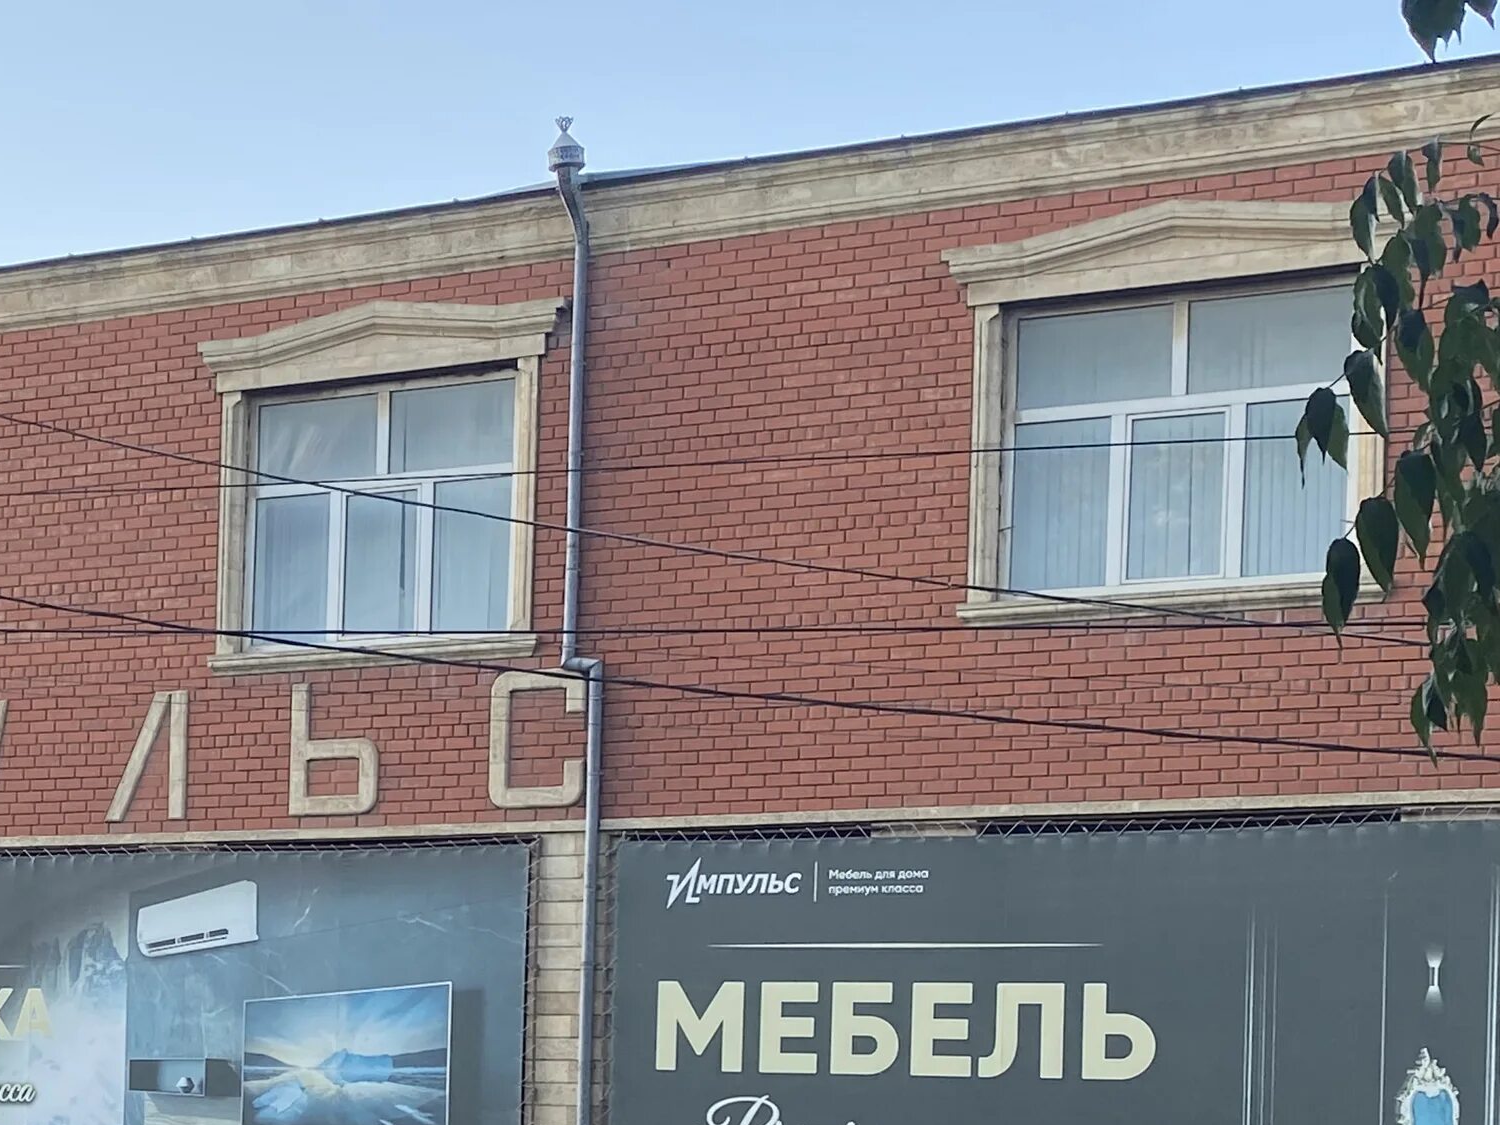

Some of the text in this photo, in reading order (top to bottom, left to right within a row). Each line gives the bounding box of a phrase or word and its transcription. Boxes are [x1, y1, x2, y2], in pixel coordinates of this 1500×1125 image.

[666, 856, 802, 909] ИМПУЛЬС
[828, 869, 929, 880] Мебель для дома
[828, 884, 924, 897] премиум класса
[655, 980, 1157, 1081] МЕБЕЛЬ
